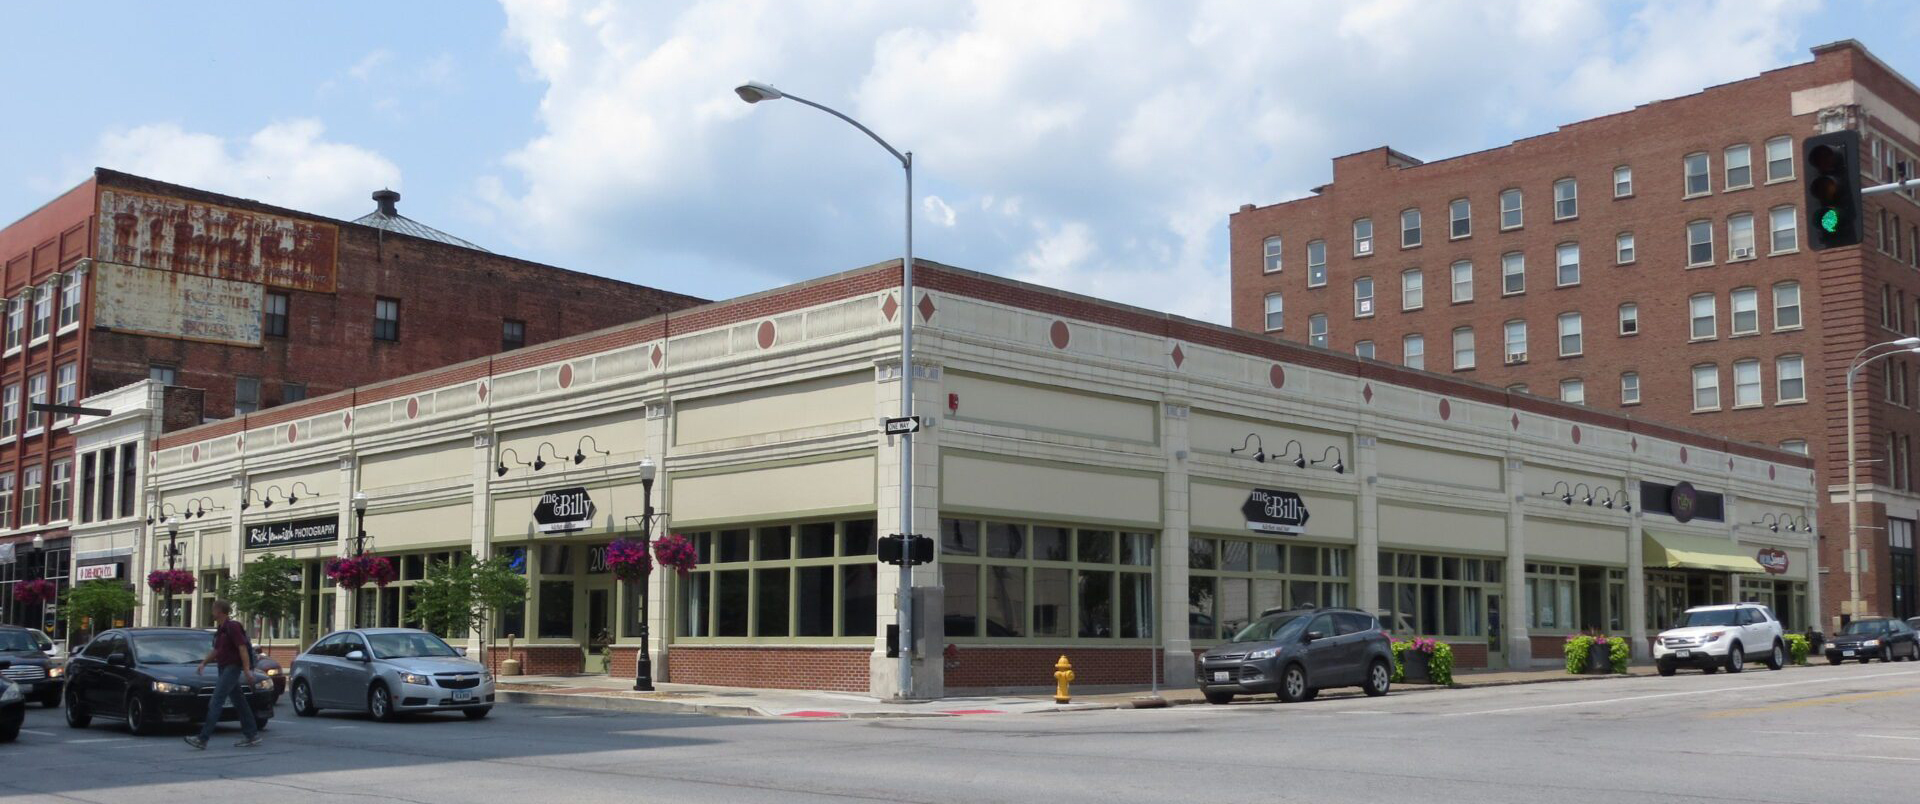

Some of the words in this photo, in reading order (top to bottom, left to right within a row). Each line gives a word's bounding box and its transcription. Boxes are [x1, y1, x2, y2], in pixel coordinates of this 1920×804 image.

[543, 493, 557, 504] me
[1252, 491, 1268, 502] me
[559, 492, 592, 522] Billy
[1272, 496, 1305, 527] Billy
[251, 525, 267, 543] Rick
[294, 524, 336, 539] PHOTOGRAPHY
